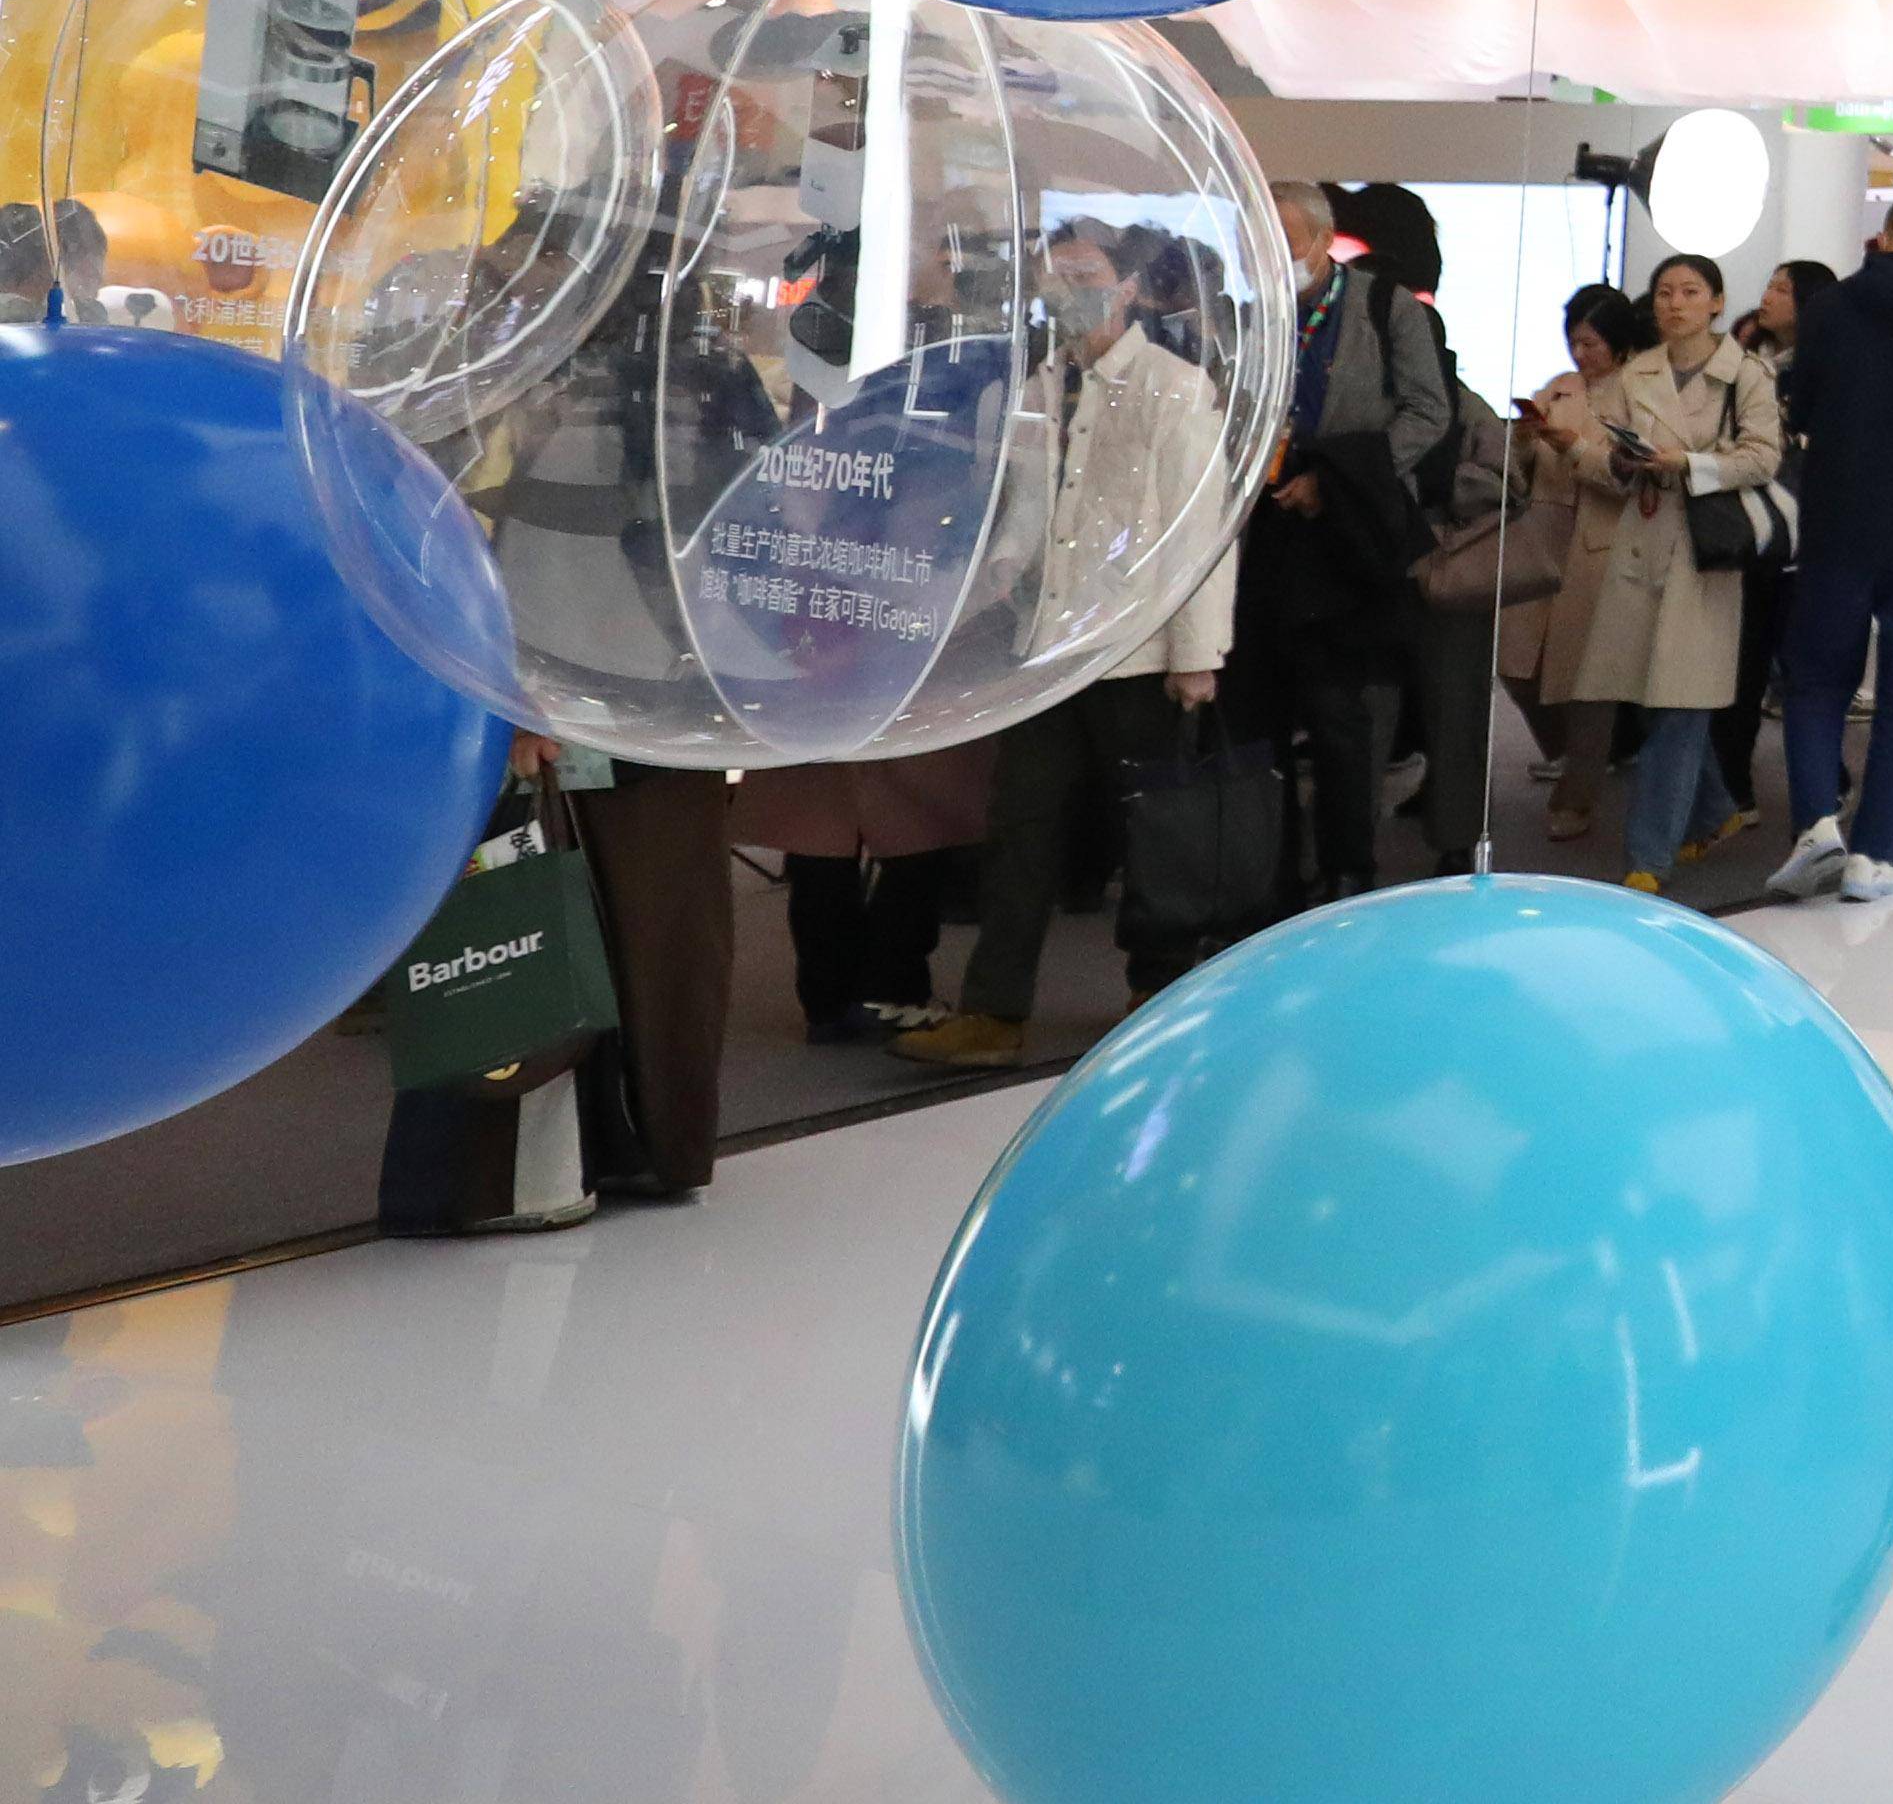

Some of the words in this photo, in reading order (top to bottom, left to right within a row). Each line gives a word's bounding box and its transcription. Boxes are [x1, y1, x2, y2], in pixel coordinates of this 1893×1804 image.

[756, 445, 895, 501] 20世纪70年代
[710, 521, 934, 586] 批量生产的意式浓缩咖啡机上市
[408, 930, 544, 992] Barbour
